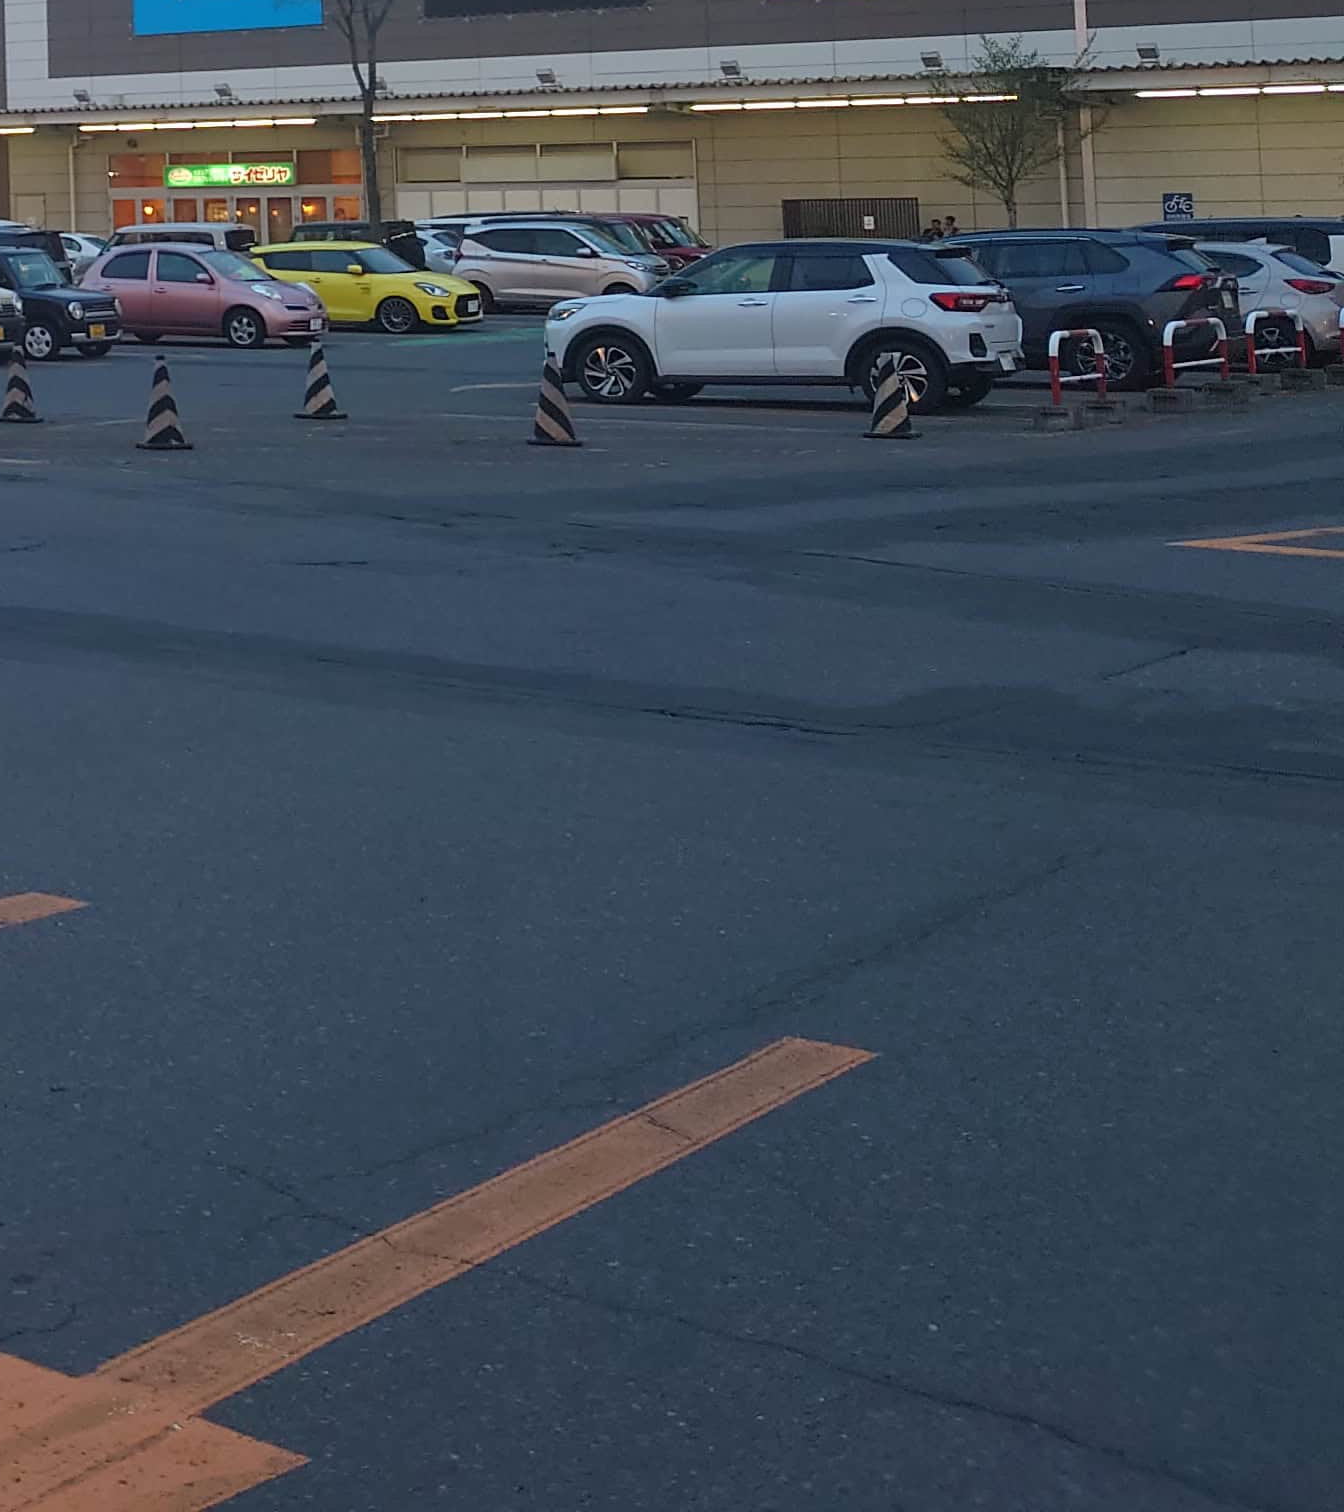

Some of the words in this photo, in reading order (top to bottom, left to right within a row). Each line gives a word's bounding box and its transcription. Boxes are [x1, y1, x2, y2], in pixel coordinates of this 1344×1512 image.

[231, 168, 290, 183] サイゼリヤ
